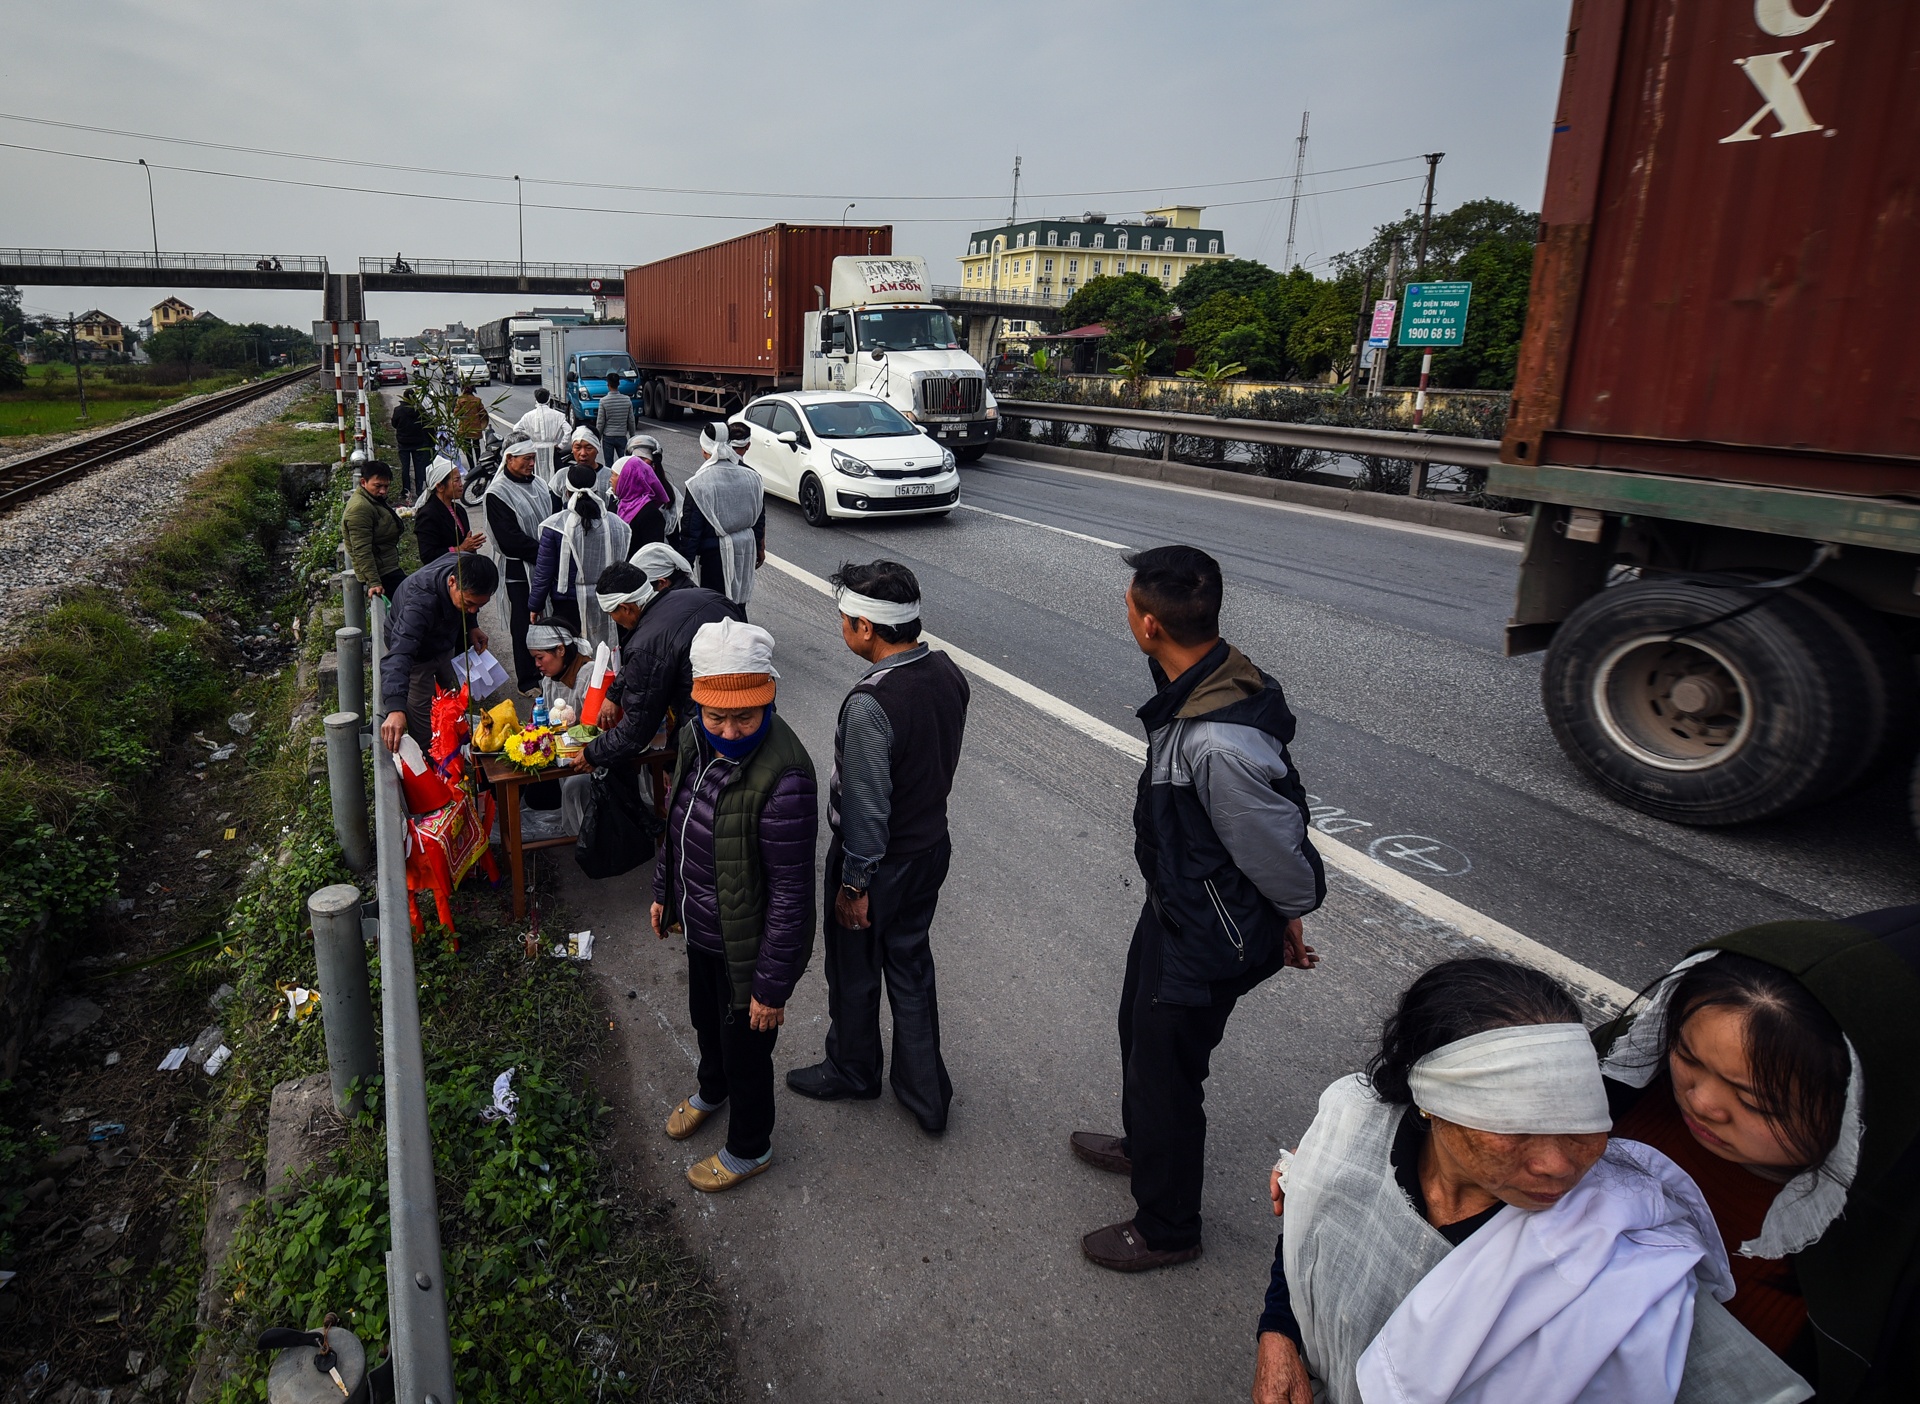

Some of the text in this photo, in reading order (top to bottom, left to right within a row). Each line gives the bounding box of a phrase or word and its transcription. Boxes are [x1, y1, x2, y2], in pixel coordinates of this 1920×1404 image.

[1413, 299, 1422, 308] SỐ
[1408, 328, 1456, 339] 1900 68 95
